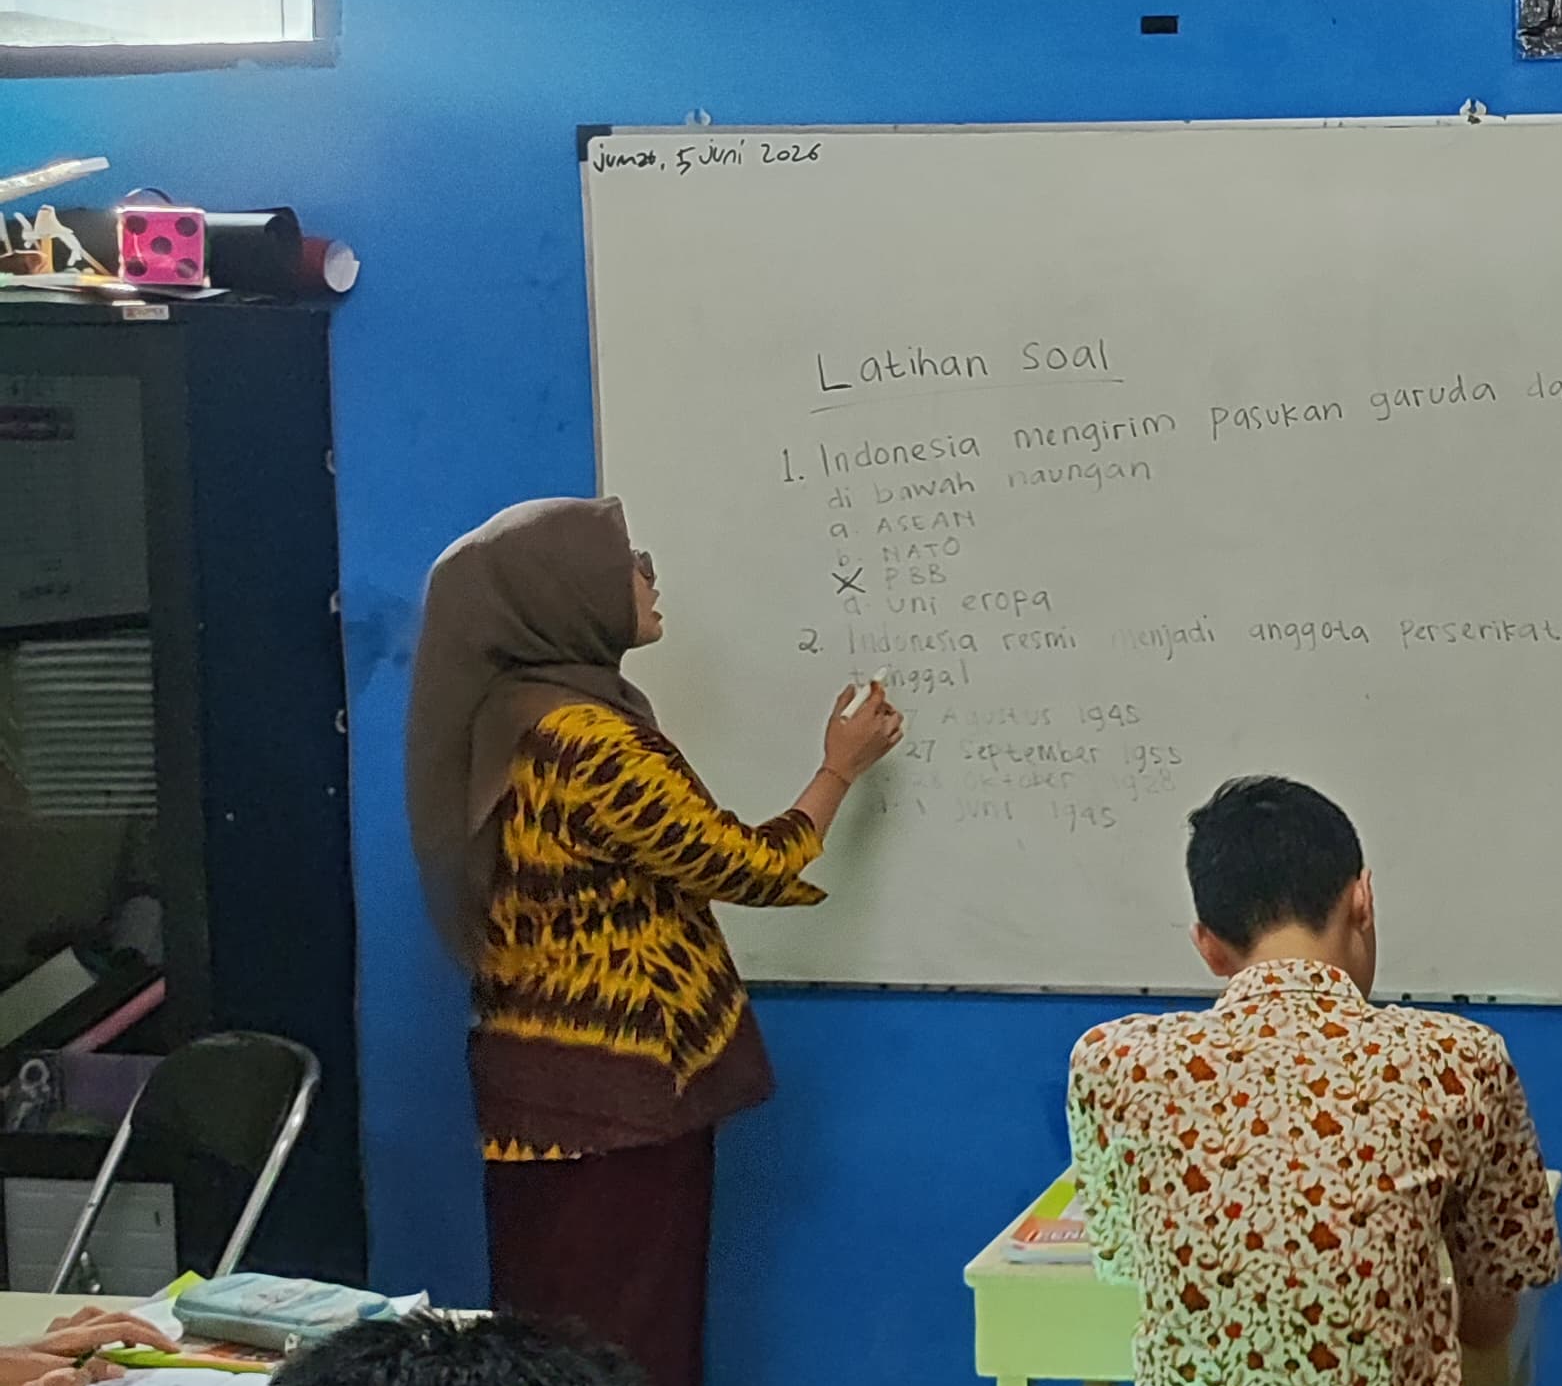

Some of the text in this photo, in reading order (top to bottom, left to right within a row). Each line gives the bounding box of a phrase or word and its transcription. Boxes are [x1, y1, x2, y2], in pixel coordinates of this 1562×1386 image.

[676, 146, 696, 176] 5
[760, 142, 821, 164] 2026
[817, 346, 989, 392] Latihan
[781, 448, 806, 483] 1.
[820, 433, 981, 477] Indonesia
[1013, 413, 1177, 452] mengirim
[1370, 374, 1497, 421] garuda
[827, 459, 1153, 509] di bawah naungan
[876, 510, 977, 535] ASEAN
[882, 535, 961, 563] NATO
[885, 563, 948, 590] PBB
[798, 627, 823, 654] 2.
[847, 621, 978, 654] Indonesia
[1001, 625, 1077, 651] resmi
[1249, 620, 1370, 650] anggota
[905, 739, 936, 763] 27
